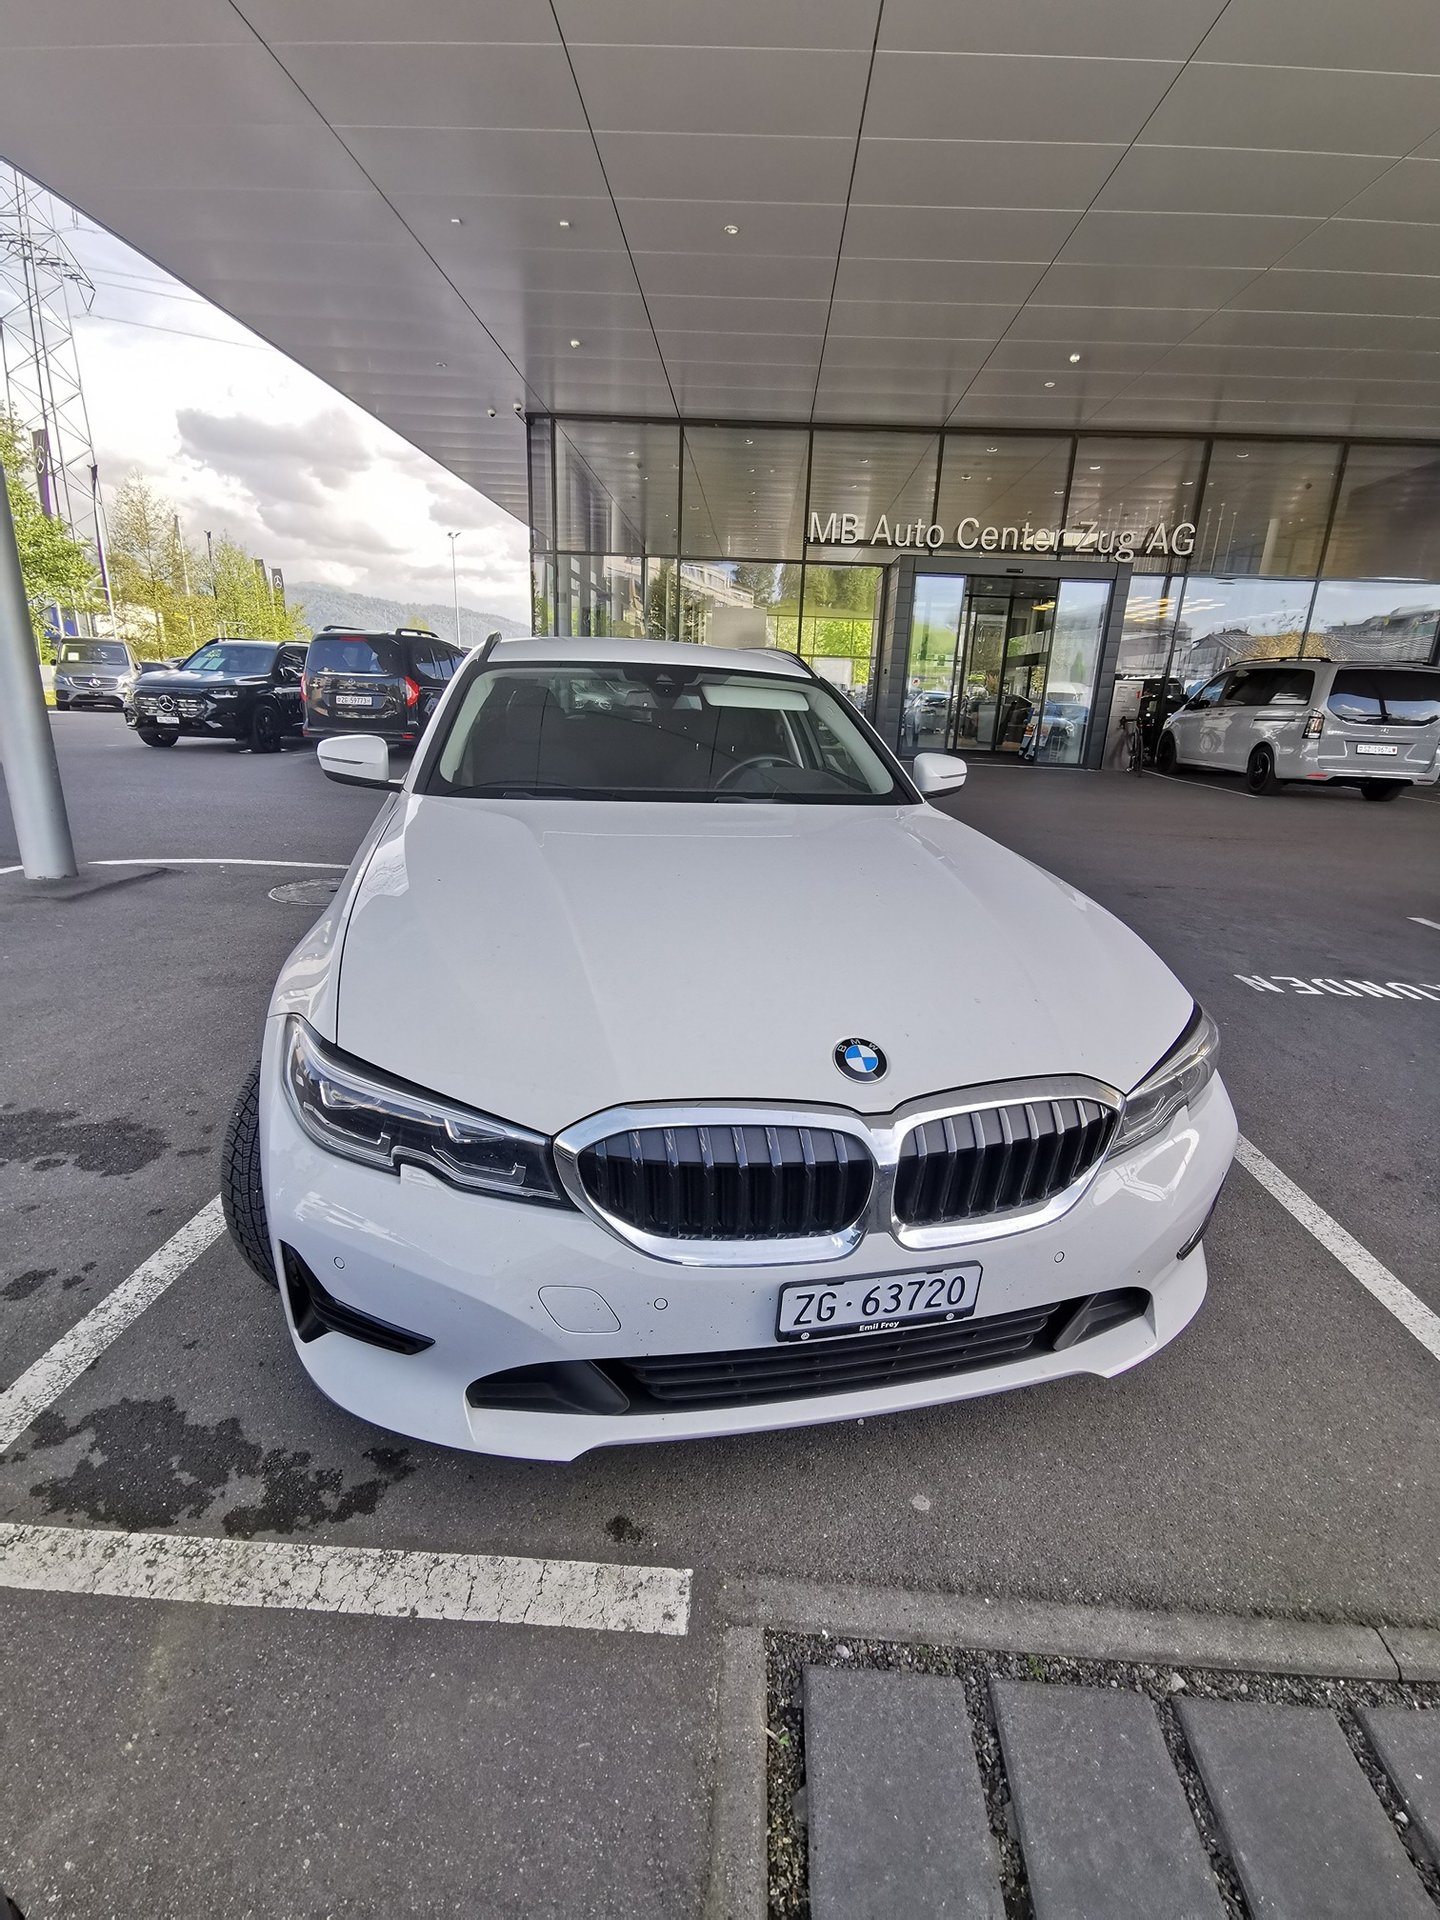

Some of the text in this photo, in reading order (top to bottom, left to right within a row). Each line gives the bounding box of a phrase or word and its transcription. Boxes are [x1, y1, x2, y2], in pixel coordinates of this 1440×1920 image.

[809, 512, 1196, 562] MB Auto Center Zug AG
[837, 1039, 879, 1053] BMW
[793, 1275, 966, 1326] ZG 63720
[859, 1320, 900, 1332] Emil Frey
